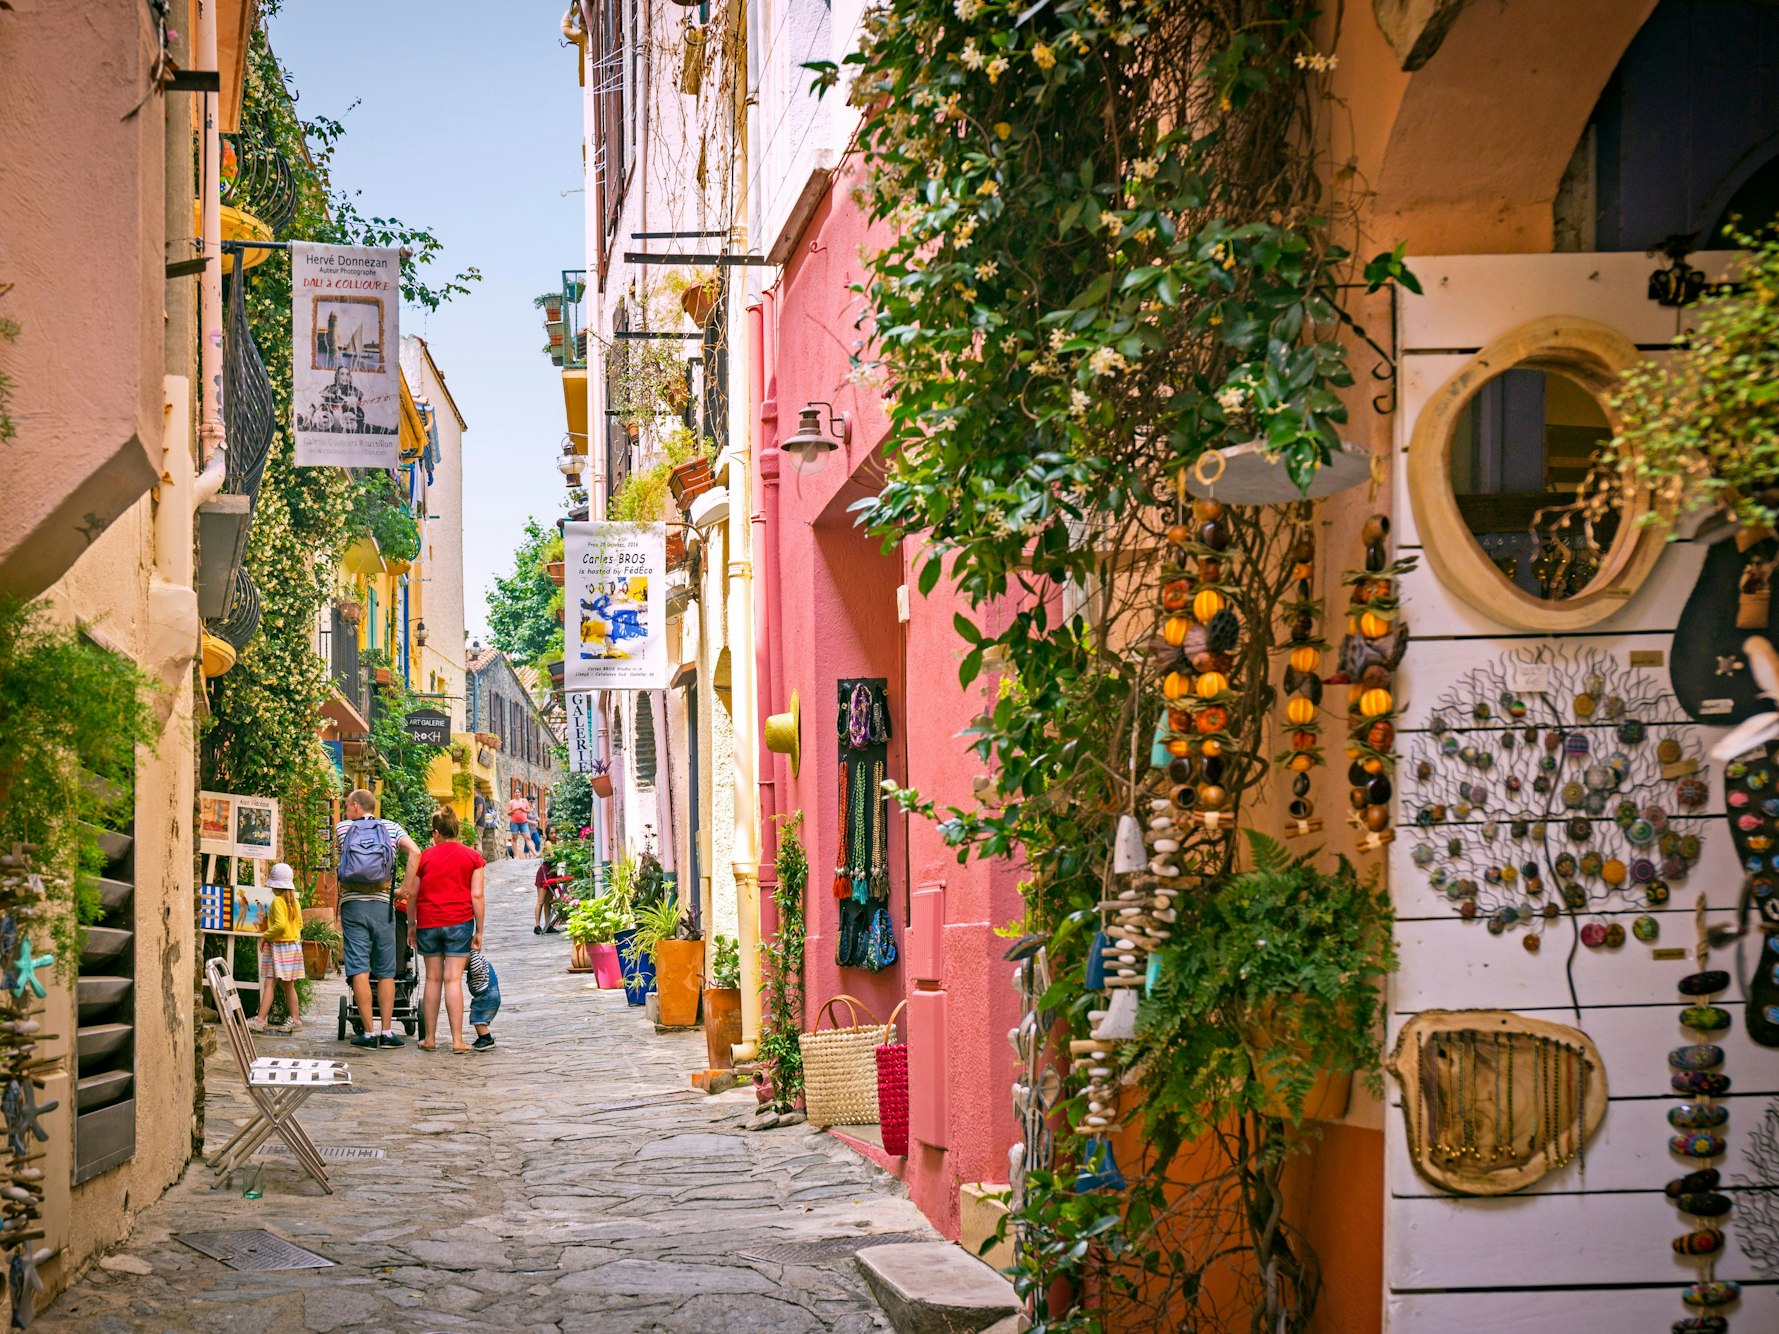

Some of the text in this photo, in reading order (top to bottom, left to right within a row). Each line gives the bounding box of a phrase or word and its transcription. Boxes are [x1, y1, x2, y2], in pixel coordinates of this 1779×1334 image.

[306, 254, 388, 268] Hervé Donnezan
[319, 266, 377, 276] Auteur Photographe
[303, 278, 323, 288] DALI
[335, 279, 390, 291] COLLIOURE
[359, 439, 393, 449] Roussillon
[582, 553, 646, 564] Carles BROS
[613, 567, 622, 576] by
[421, 719, 445, 727] GALERIE
[414, 730, 441, 742] ROCH
[572, 693, 588, 773] GALERIE
